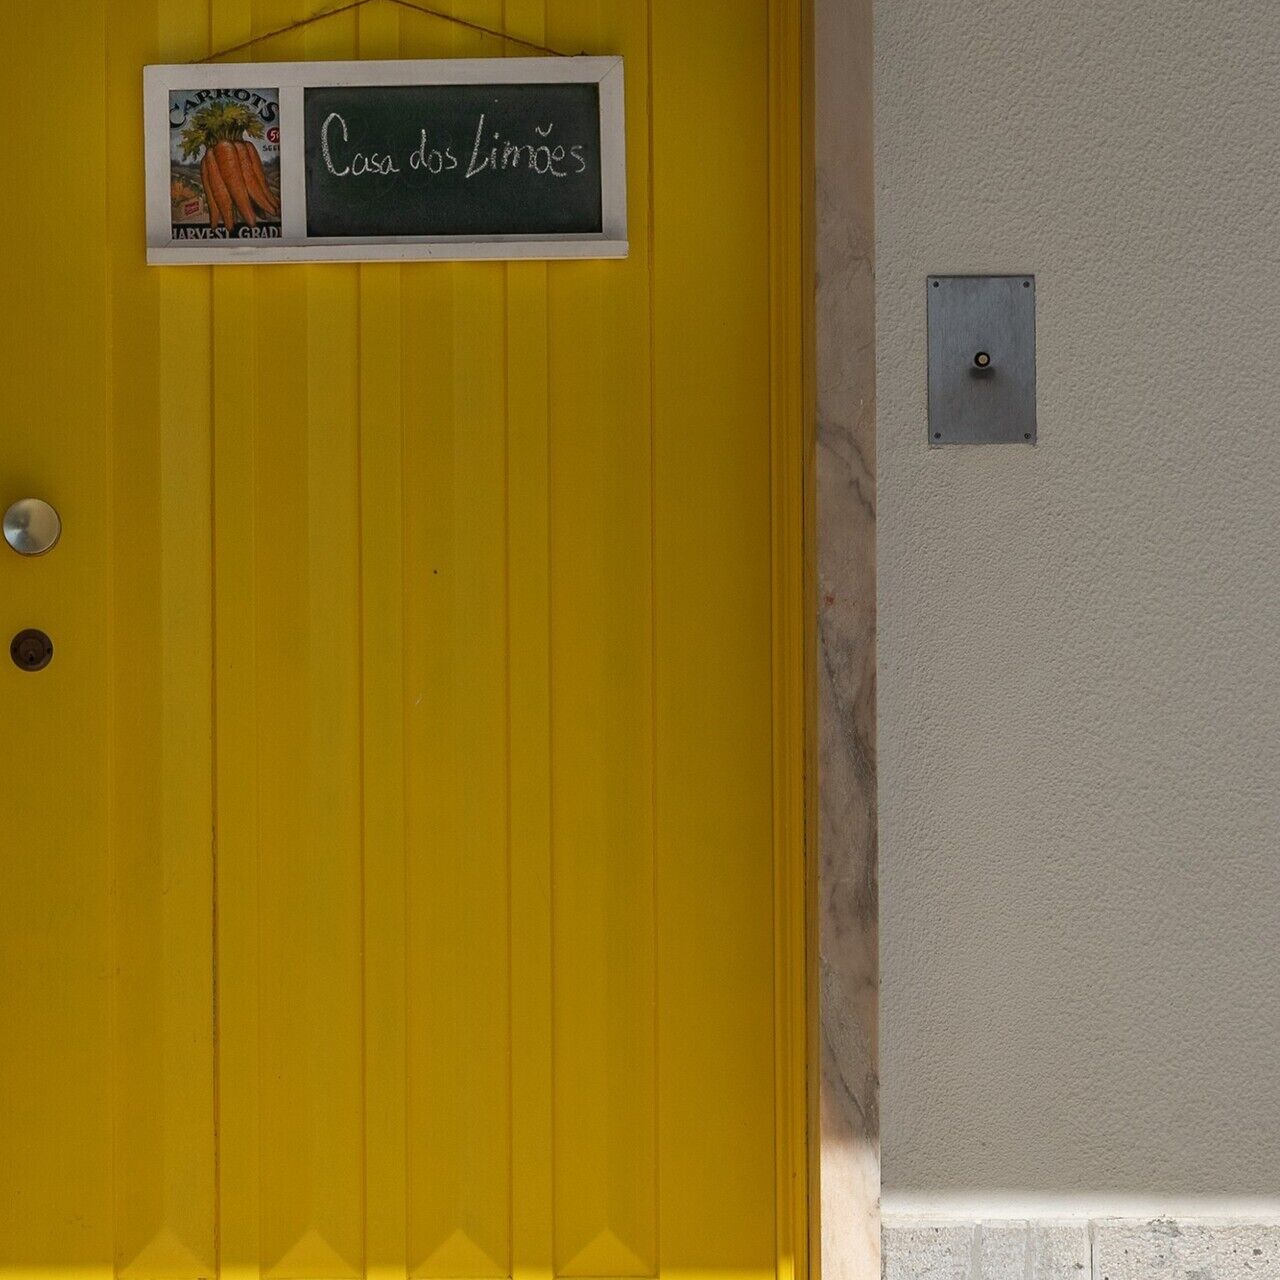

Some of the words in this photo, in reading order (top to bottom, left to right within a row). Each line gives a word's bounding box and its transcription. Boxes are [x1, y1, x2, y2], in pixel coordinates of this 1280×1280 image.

[169, 89, 280, 128] CARROTS
[321, 113, 400, 176] Casa
[410, 128, 458, 174] dos
[465, 114, 586, 179] Limões
[238, 226, 282, 239] GRAD
